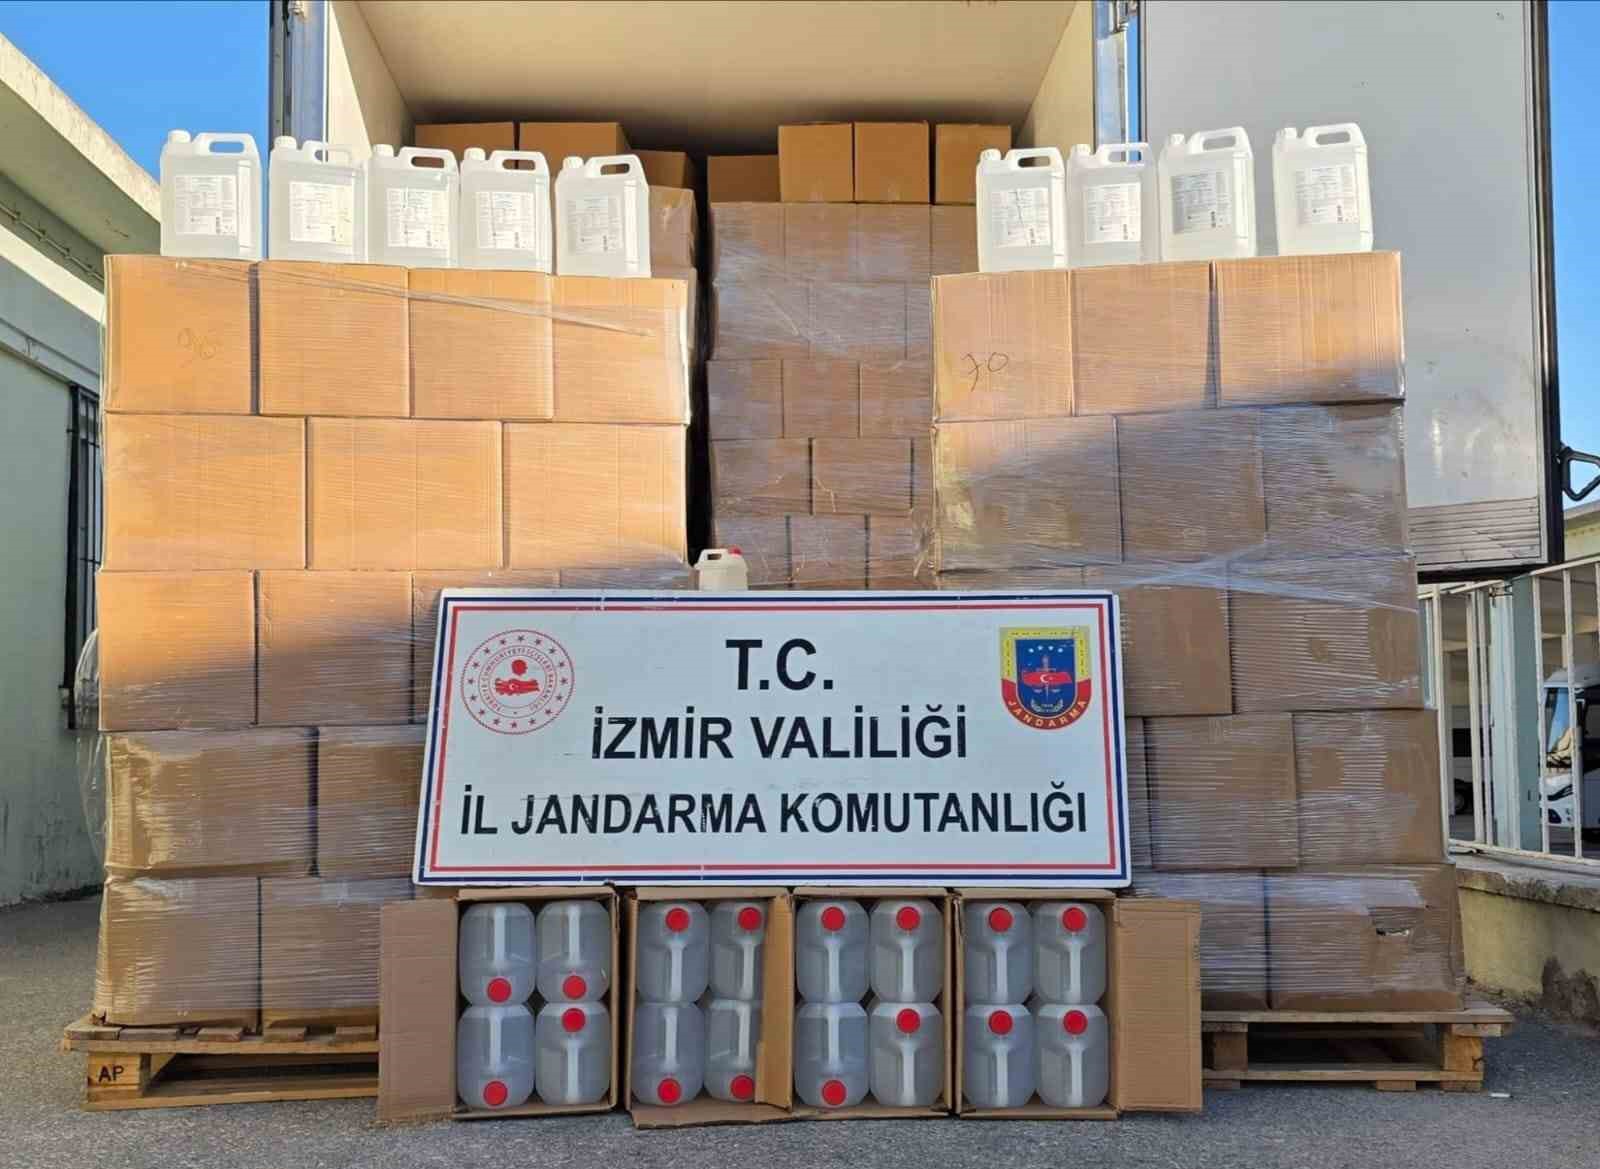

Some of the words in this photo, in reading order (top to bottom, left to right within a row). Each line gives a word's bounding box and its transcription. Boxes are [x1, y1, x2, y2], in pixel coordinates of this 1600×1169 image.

[725, 638, 833, 690] T.C.
[591, 706, 733, 759] İZMİR
[751, 704, 967, 759] VALİLİĞİ
[1006, 699, 1088, 728] JANDARMA
[461, 784, 498, 835] İL
[512, 794, 767, 835] JANDARMA
[780, 782, 1087, 833] KOMUTANLIĞI
[98, 1065, 125, 1083] AP
